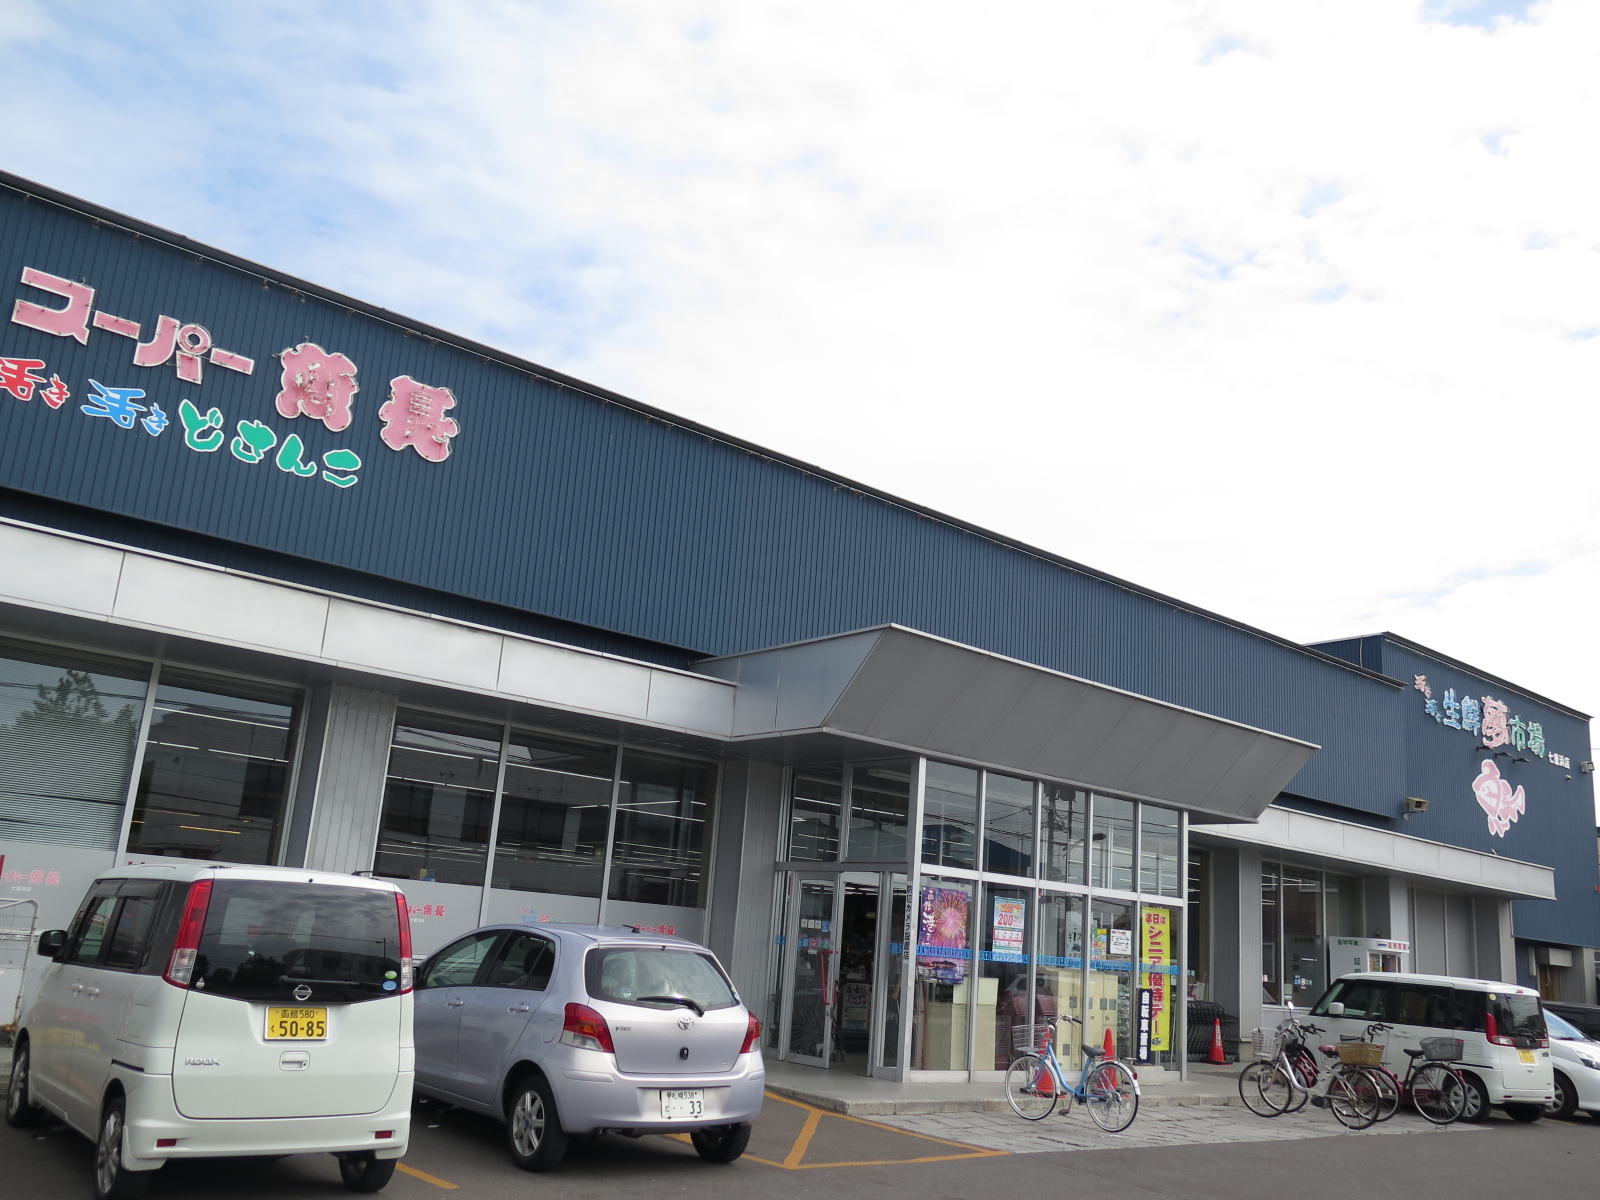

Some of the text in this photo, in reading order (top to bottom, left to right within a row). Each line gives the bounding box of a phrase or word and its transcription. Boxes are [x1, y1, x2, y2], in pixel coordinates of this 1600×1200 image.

[998, 913, 1013, 926] 200
[1145, 913, 1166, 925] 本日は
[279, 1020, 325, 1037] 50-85
